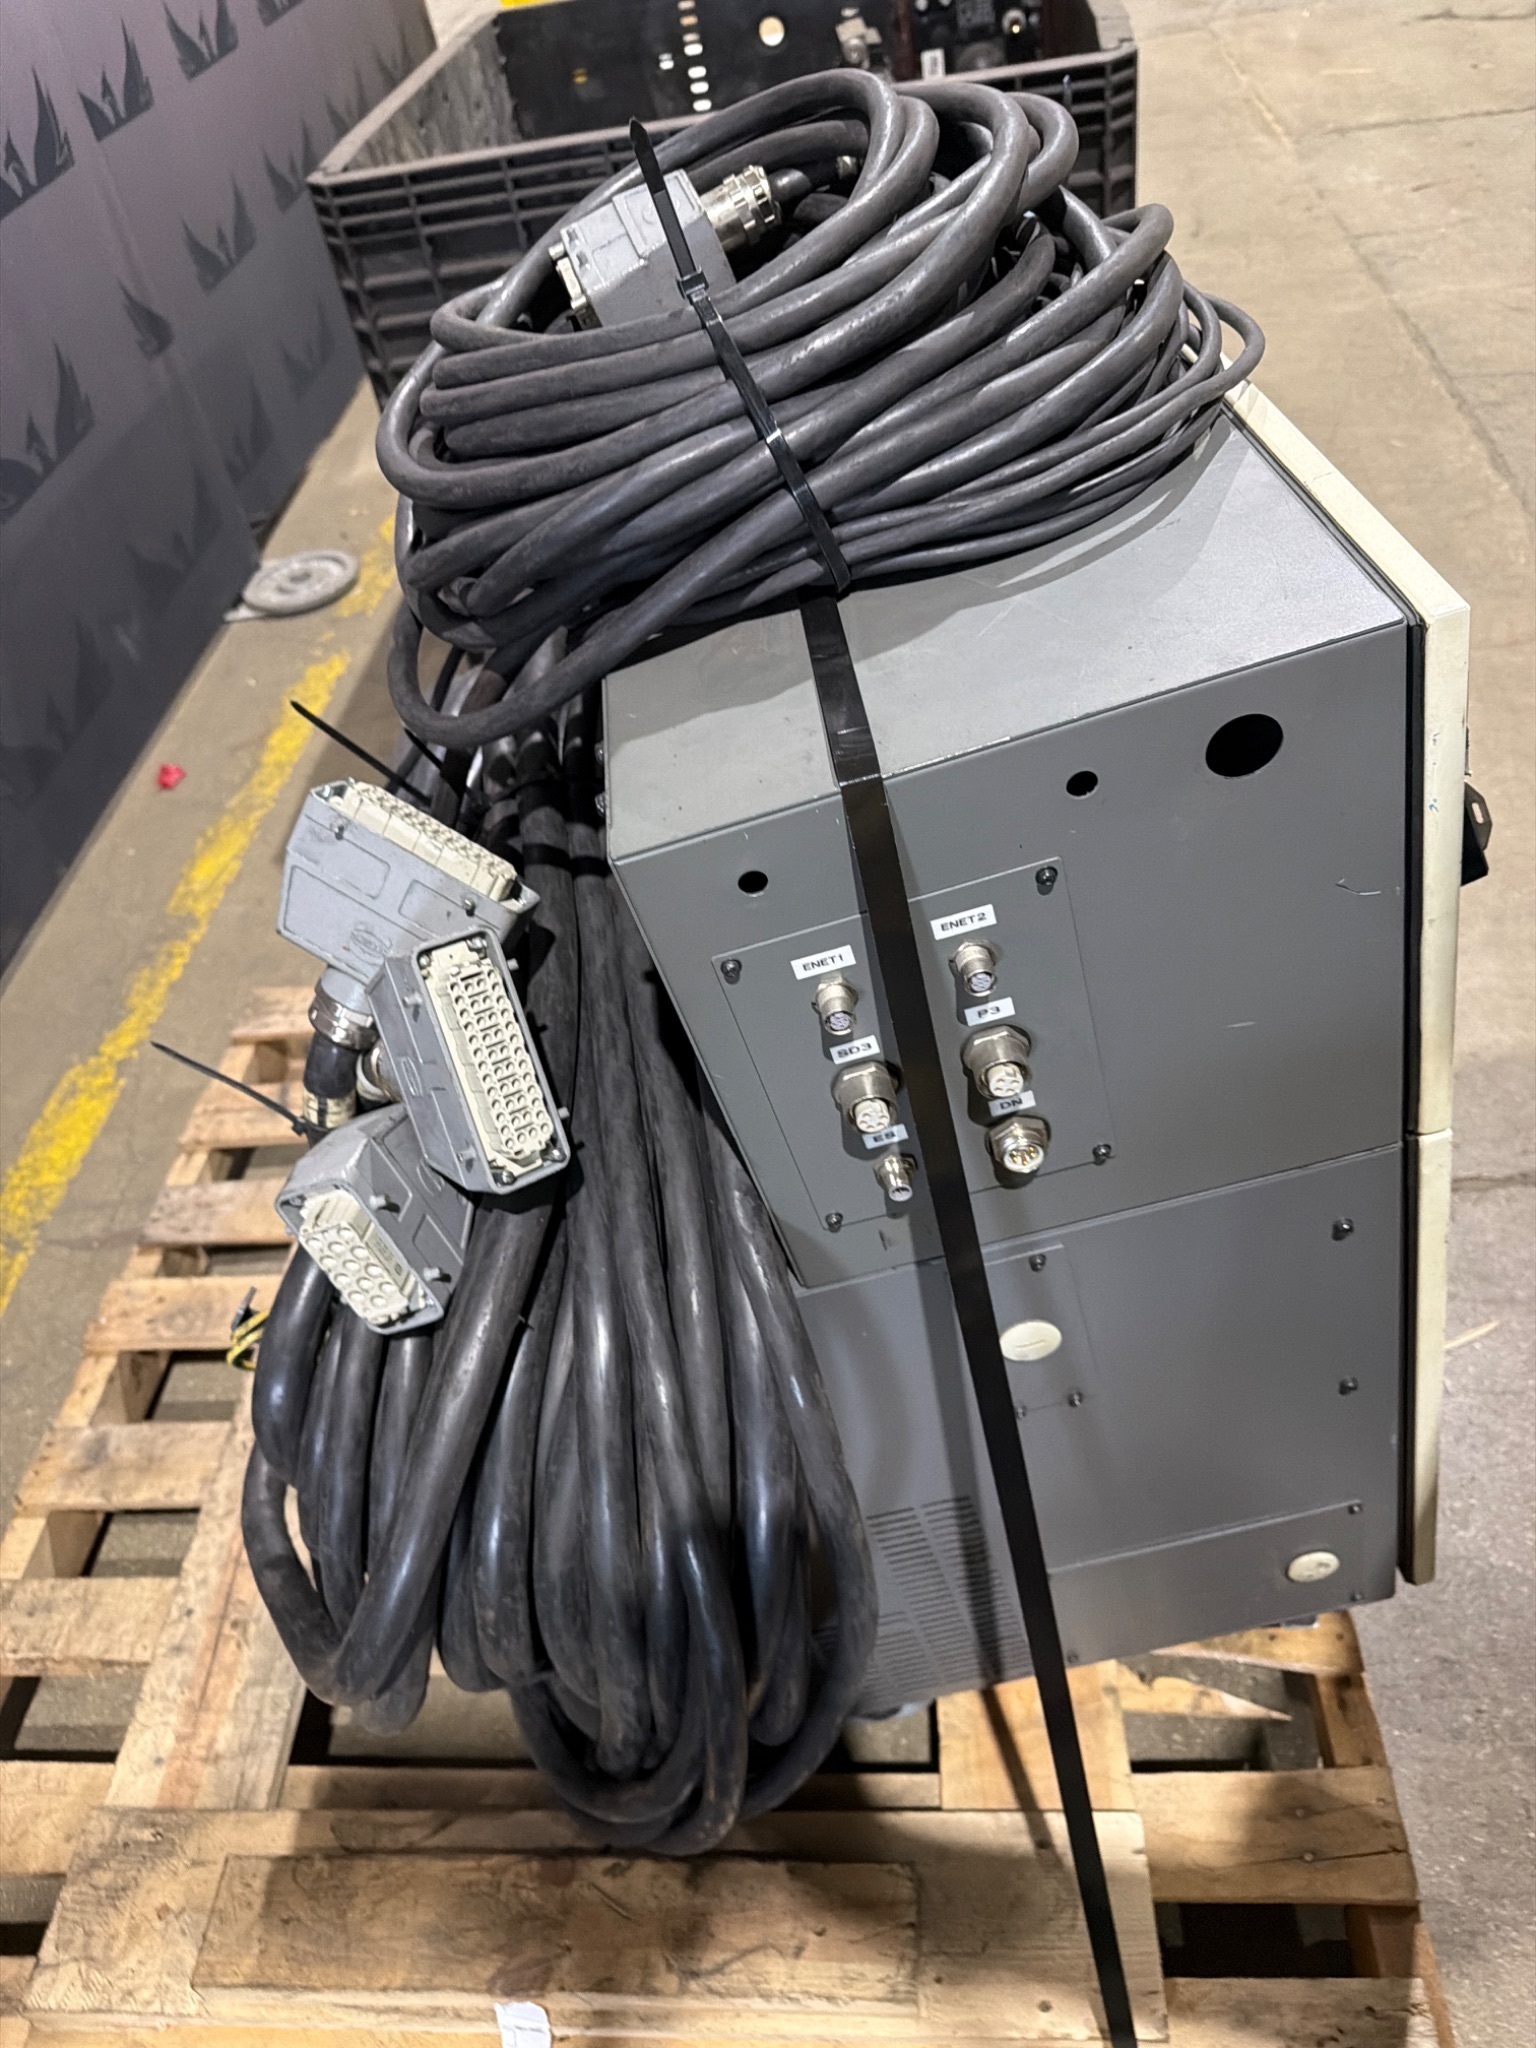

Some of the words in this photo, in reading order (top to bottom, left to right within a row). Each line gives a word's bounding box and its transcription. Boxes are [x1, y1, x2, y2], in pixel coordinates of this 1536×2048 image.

[940, 912, 987, 931] ENET2
[802, 954, 844, 971] ENET1
[977, 1006, 1001, 1018] P3
[1000, 1098, 1023, 1110] DN
